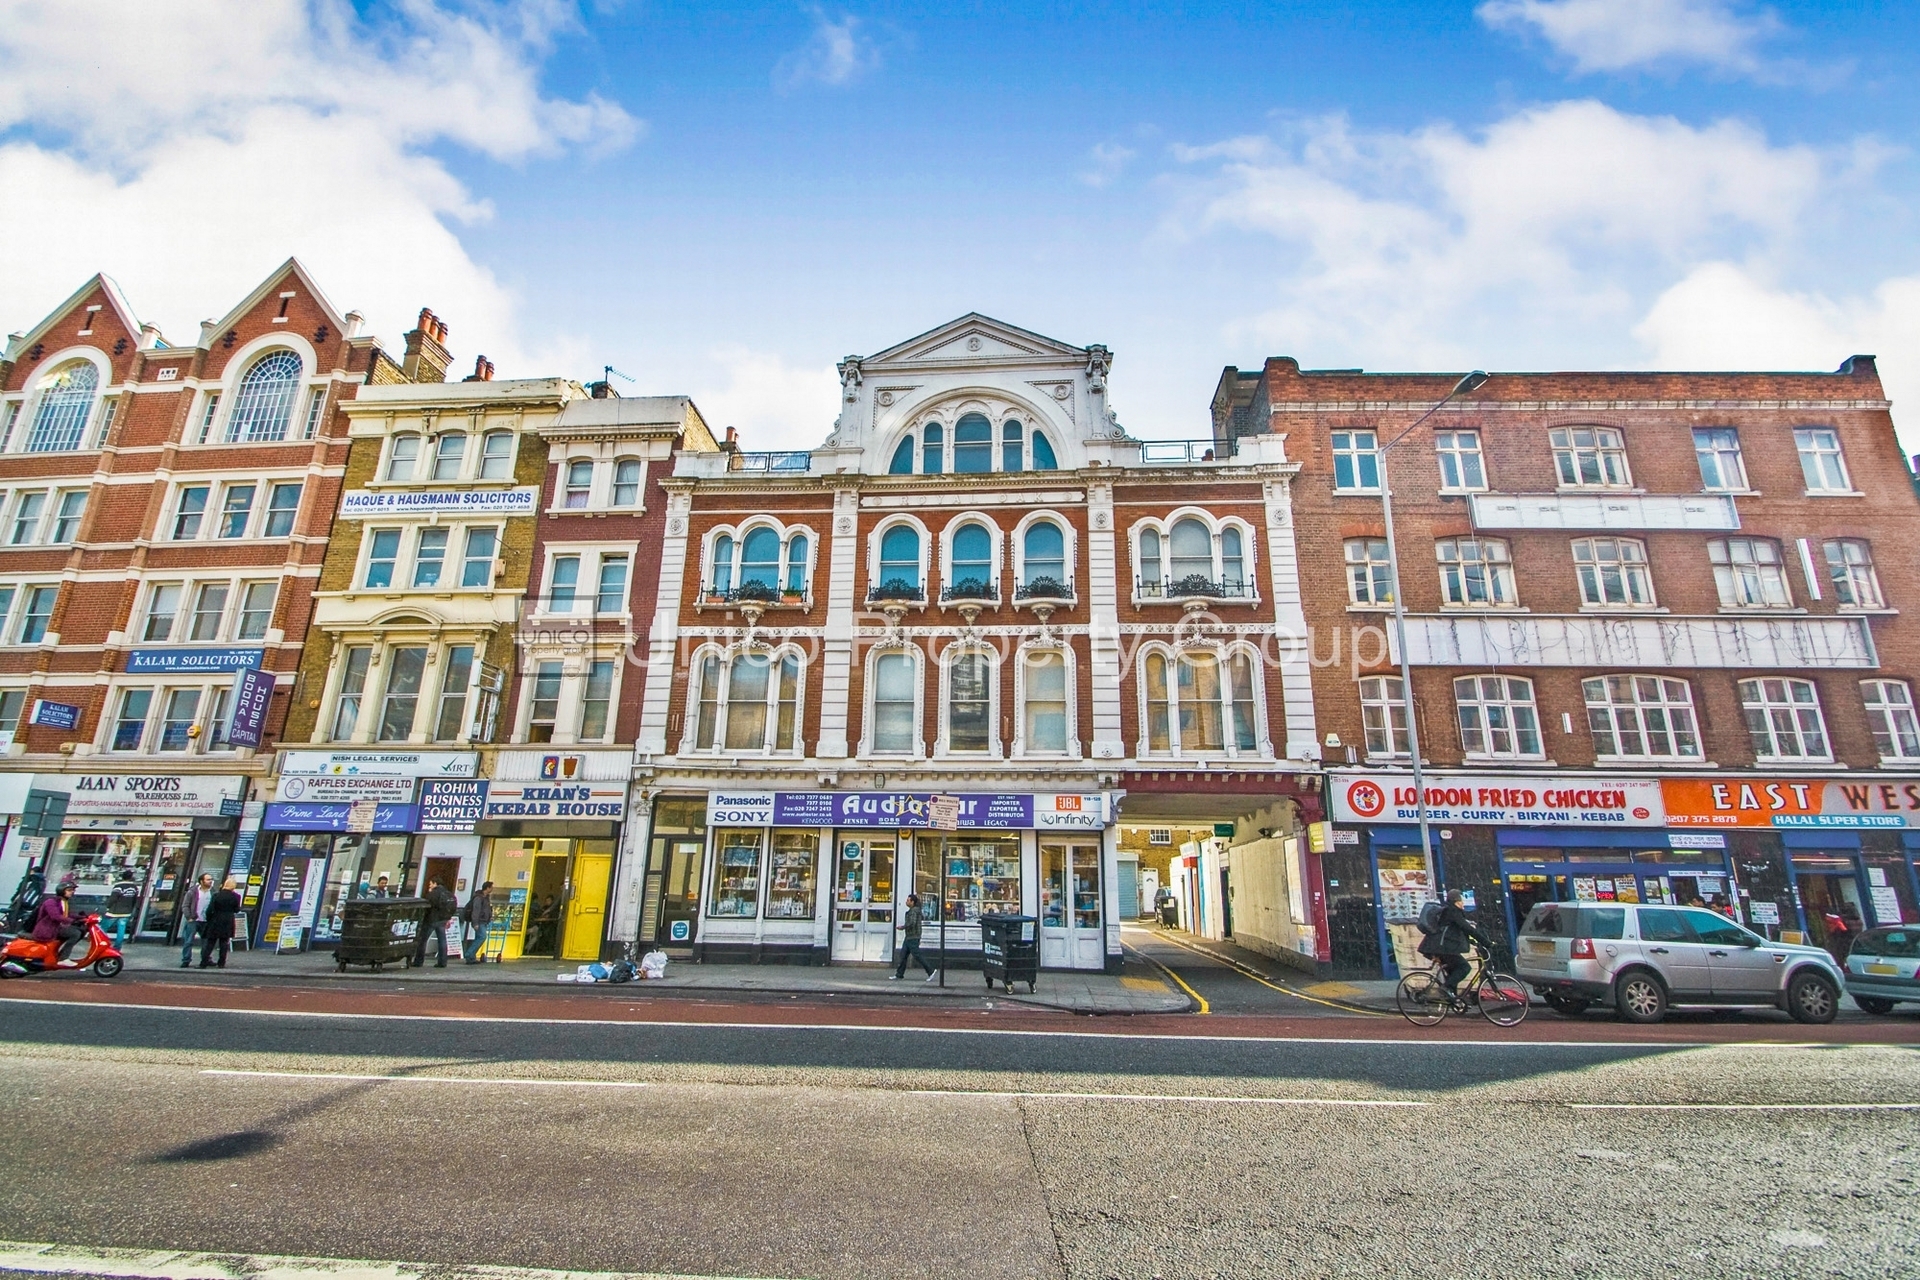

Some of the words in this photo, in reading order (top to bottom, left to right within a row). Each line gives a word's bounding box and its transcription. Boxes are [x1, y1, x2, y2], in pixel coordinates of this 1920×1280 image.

[346, 495, 385, 506] HAQUE
[387, 495, 394, 505] &
[398, 493, 460, 505] HAUSMANN
[463, 492, 531, 504] SOLICITORS
[134, 656, 177, 666] KALAM
[181, 655, 255, 666] SOLICITORS
[249, 686, 267, 728] HOUSE
[232, 728, 257, 743] CAPITAL
[76, 777, 118, 791] JAAN
[125, 777, 181, 791] SPORTS
[308, 778, 346, 787] RAFFLES
[348, 779, 394, 788] EXCHANGE
[396, 780, 412, 788] LTD.
[433, 782, 477, 793] ROHIM
[182, 793, 198, 801] LTD.
[522, 785, 590, 801] KHAN'S
[1394, 787, 1473, 807] LONDON
[1477, 788, 1537, 807] FRIED
[1543, 789, 1627, 809] CHICKEN
[1711, 783, 1811, 810] EAST
[1840, 784, 1920, 811] WES
[424, 795, 482, 806] BUSINESS
[716, 795, 771, 806] Panasonic
[1059, 797, 1079, 809] JBL
[280, 805, 313, 817] Prime
[316, 805, 350, 818] Land
[423, 807, 481, 818] COMPLEX
[487, 803, 551, 815] KEBAB
[556, 803, 622, 816] HOUSE
[714, 811, 768, 822] SONY
[1056, 813, 1096, 826] Infinity
[1461, 810, 1506, 820] CURRY
[1517, 811, 1570, 821] BIRYANI
[1581, 812, 1625, 822] KEBAB
[1665, 815, 1688, 823] 0207
[1775, 815, 1816, 825] HALAL
[1820, 815, 1859, 825] SUPER
[1862, 816, 1901, 826] STORE
